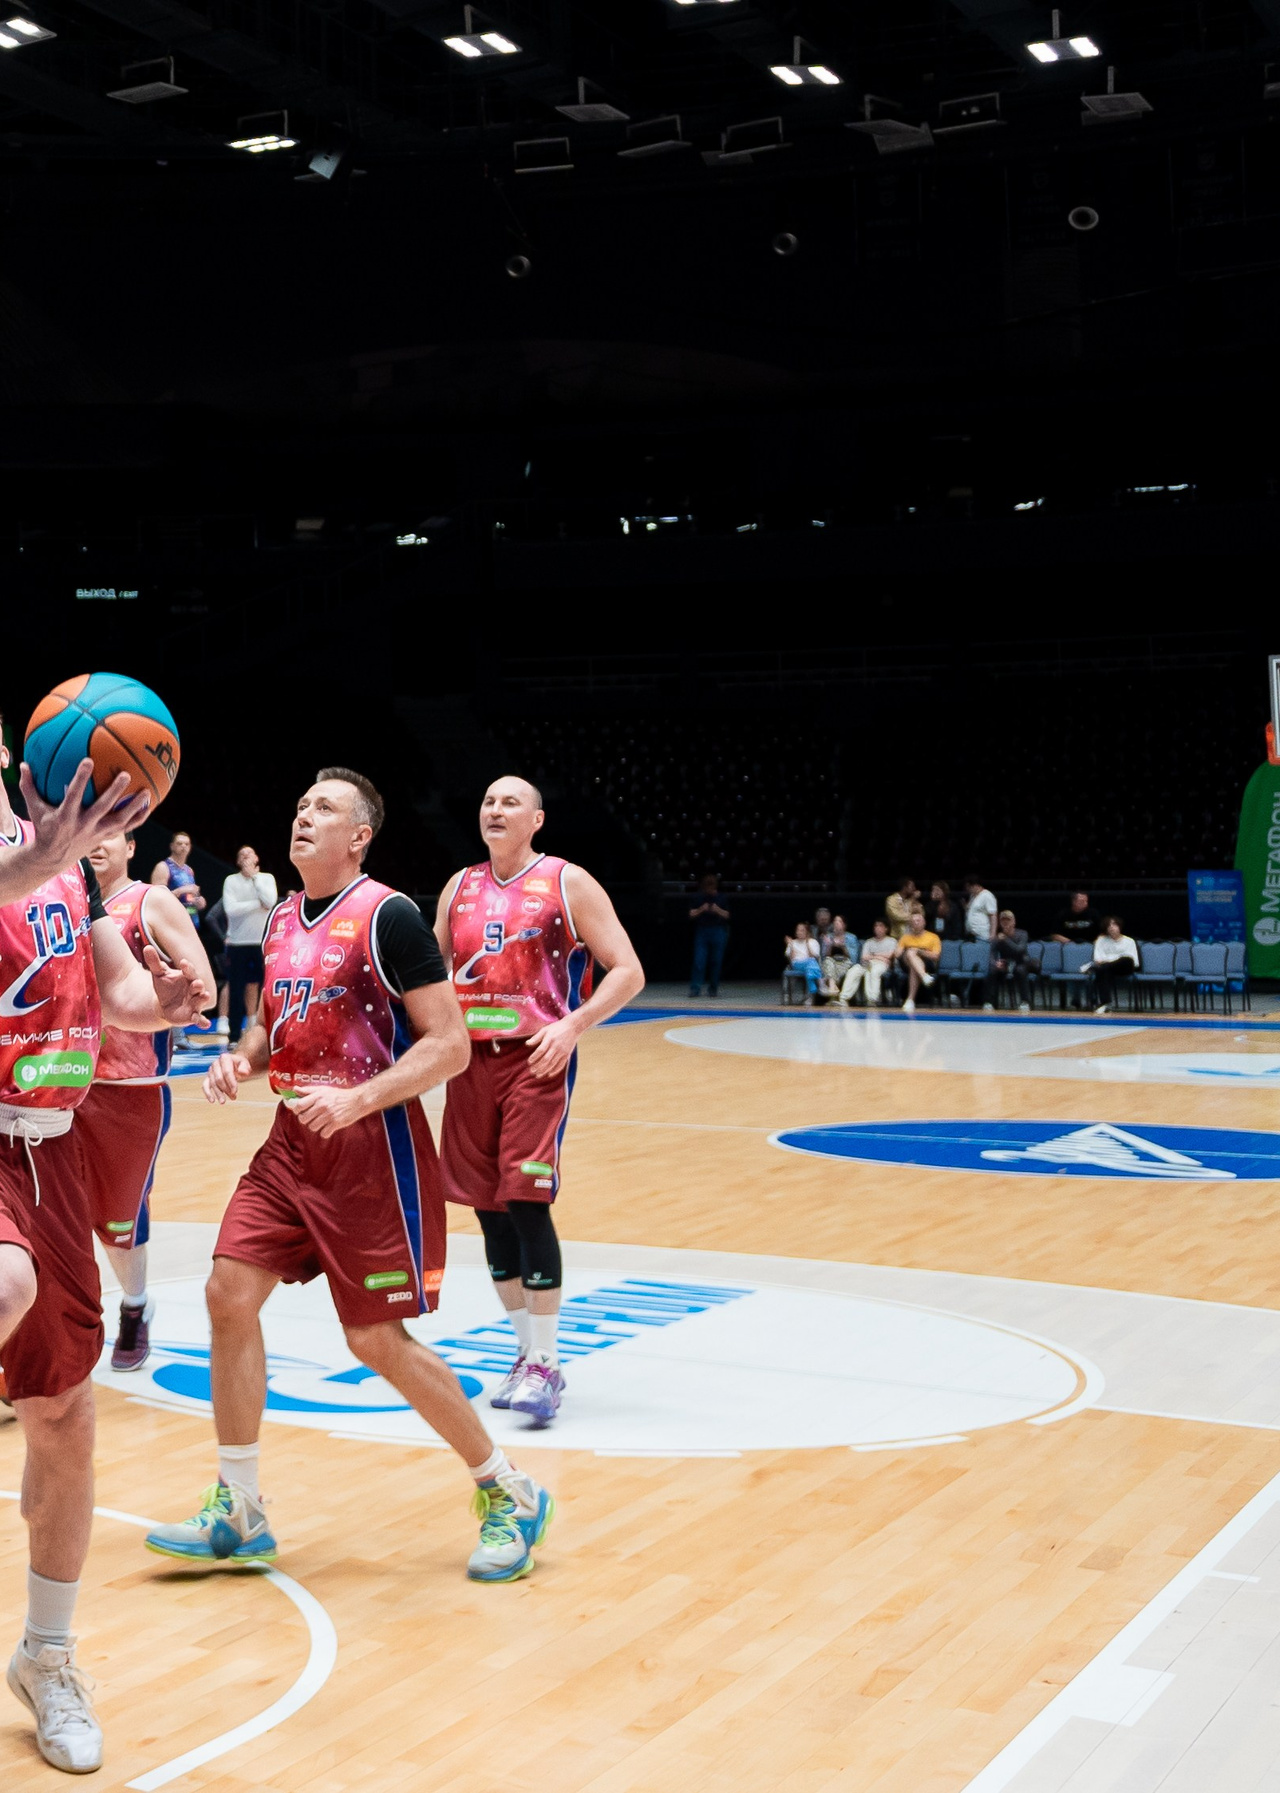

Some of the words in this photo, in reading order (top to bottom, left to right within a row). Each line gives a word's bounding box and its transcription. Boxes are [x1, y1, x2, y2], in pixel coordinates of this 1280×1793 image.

[75, 588, 117, 600] ВЫХОД
[25, 902, 77, 958] 10
[483, 921, 505, 955] 9
[272, 976, 315, 1023] 77
[294, 1073, 348, 1085] РОССИИ
